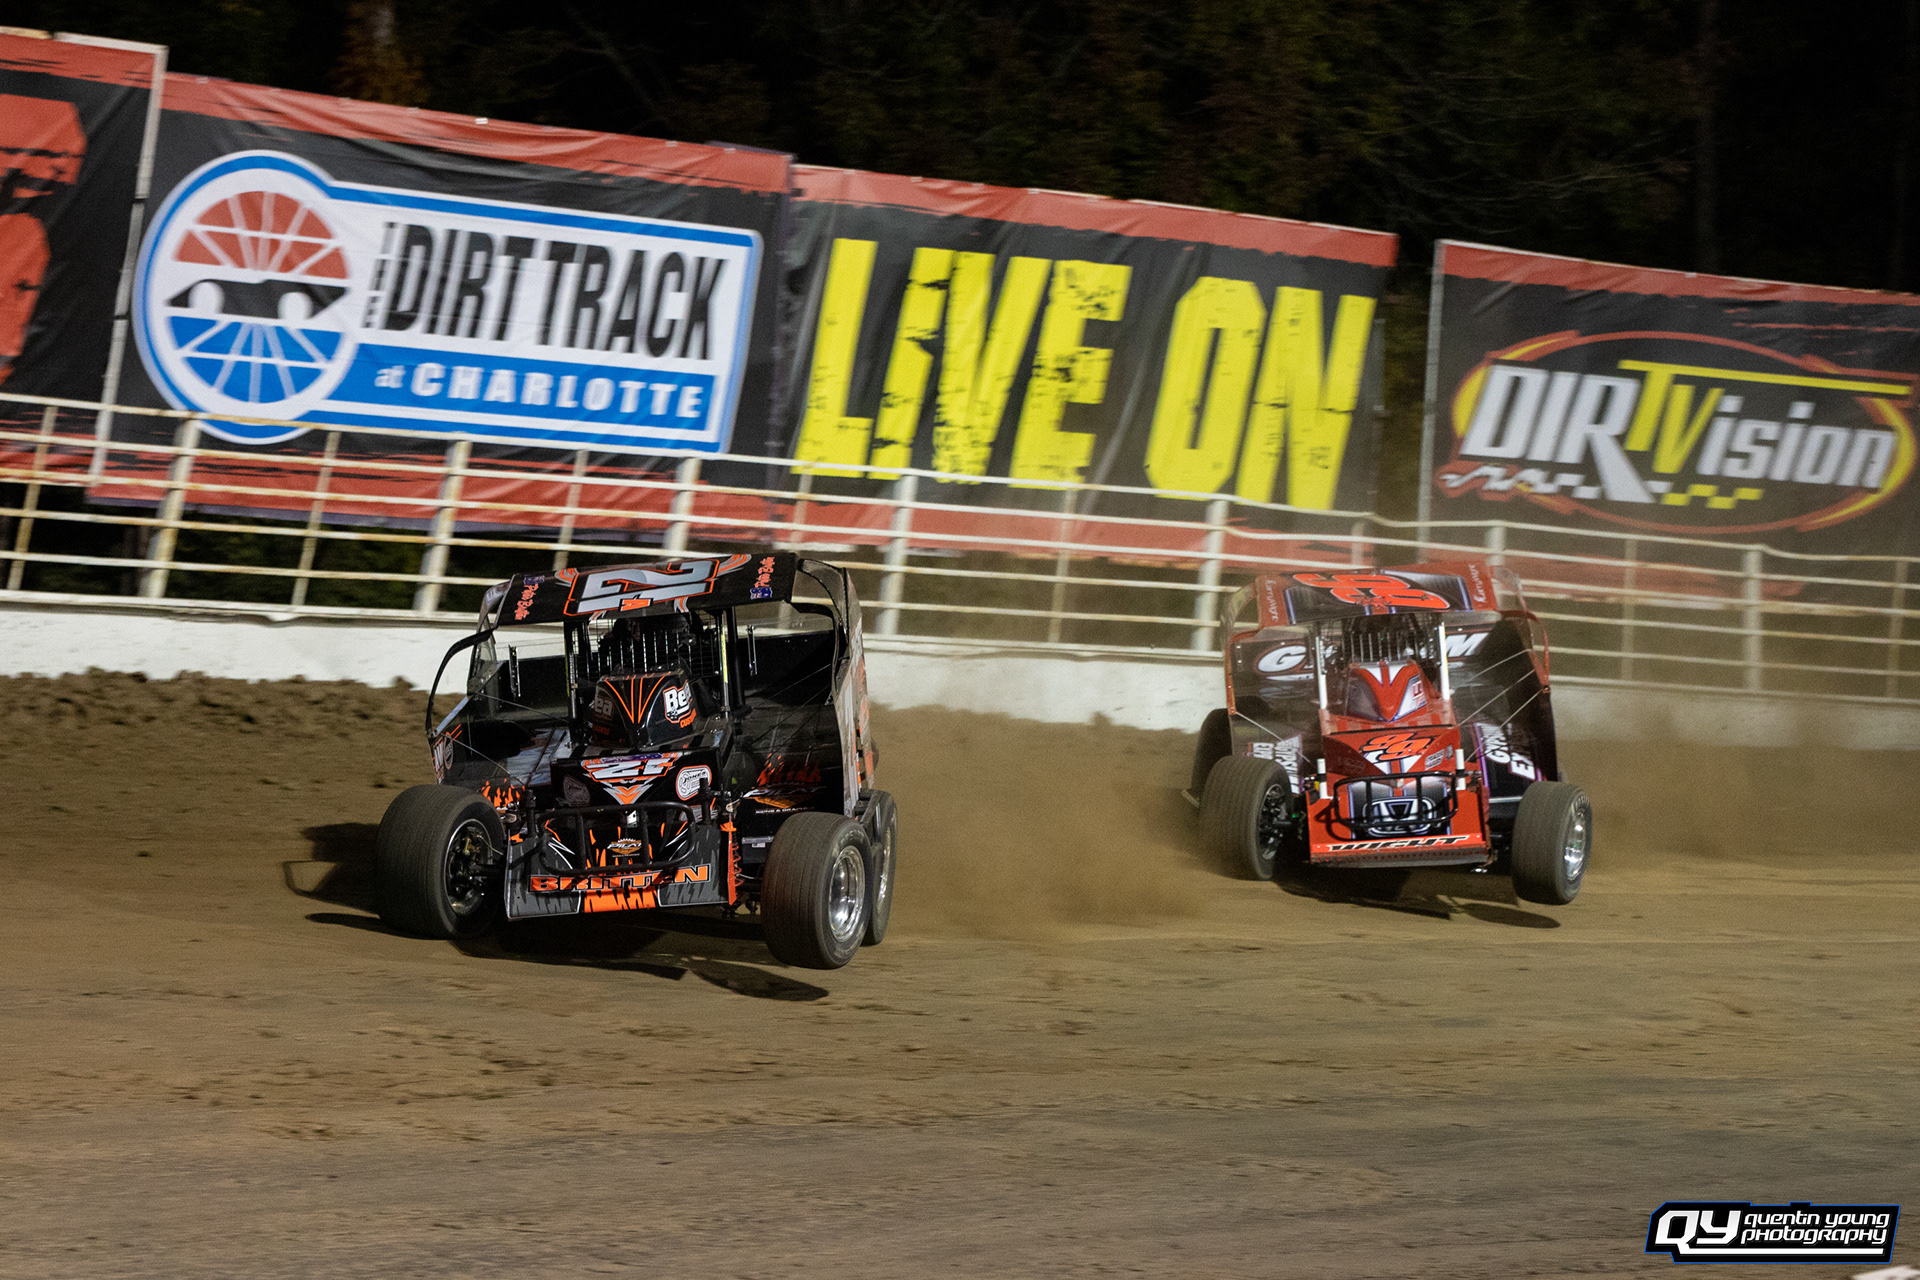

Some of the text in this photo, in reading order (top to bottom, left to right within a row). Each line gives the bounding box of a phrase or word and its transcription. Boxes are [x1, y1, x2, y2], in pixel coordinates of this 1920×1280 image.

[383, 223, 730, 361] DIRT TRACK
[374, 361, 704, 419] at CHARLOTTE
[792, 238, 1377, 511] LIVE ON
[1327, 835, 1469, 852] WIGHT
[529, 863, 711, 893] BRITTEN
